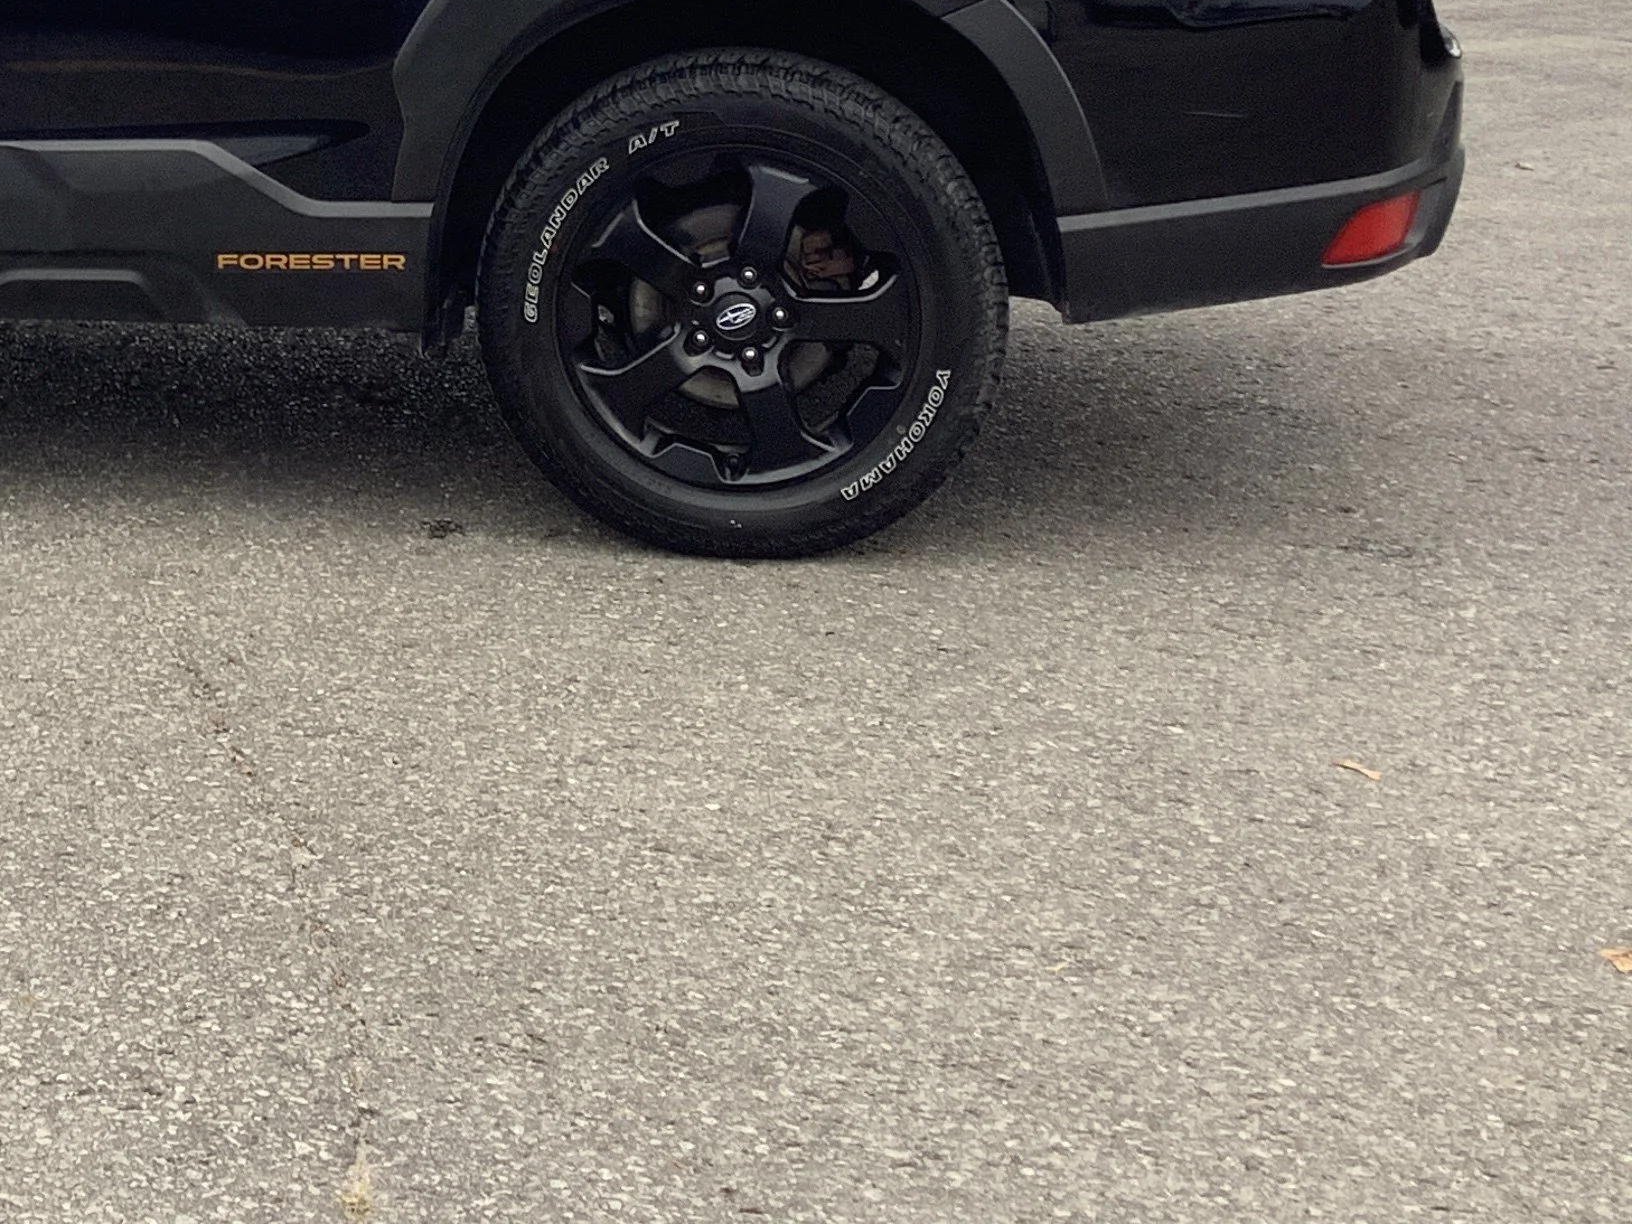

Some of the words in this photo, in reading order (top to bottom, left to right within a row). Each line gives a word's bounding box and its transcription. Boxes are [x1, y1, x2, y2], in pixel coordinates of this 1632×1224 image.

[217, 254, 407, 270] FORESTER
[523, 157, 610, 323] GEOLANDAR
[628, 120, 680, 155] A/T
[841, 369, 951, 500] YOKOHAMA
